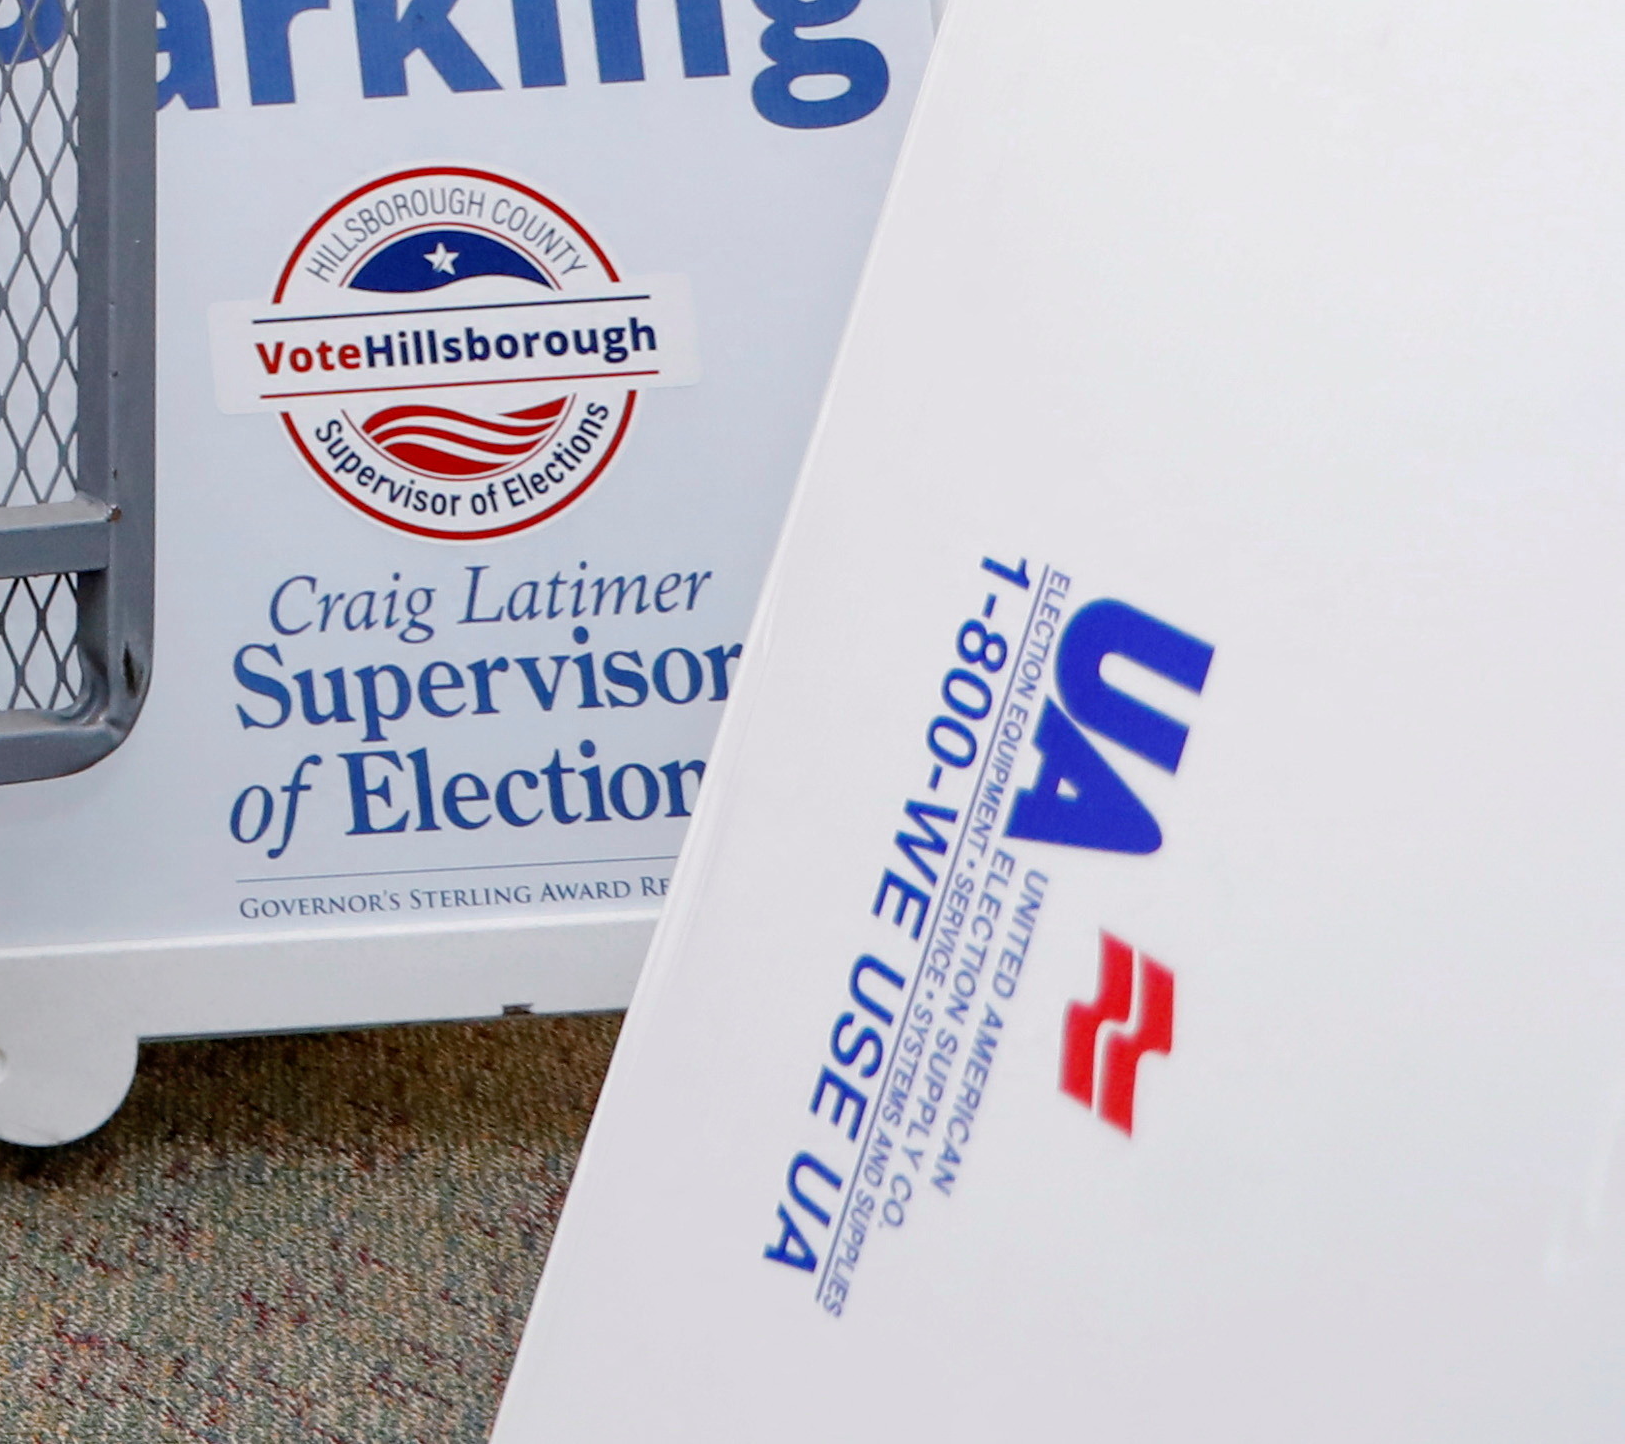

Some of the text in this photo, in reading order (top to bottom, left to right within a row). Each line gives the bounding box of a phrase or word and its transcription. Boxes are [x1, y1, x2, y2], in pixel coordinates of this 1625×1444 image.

[305, 187, 589, 283] HILLSBOROUGH COUNTY
[256, 316, 657, 376] VoteHillsborough
[315, 401, 610, 517] Supervisor of Elections
[269, 561, 712, 643] Craig Latimer
[232, 627, 743, 743] Supervisor
[1004, 596, 1216, 857] UA
[230, 739, 708, 859] of Election
[239, 889, 401, 920] GOVERNOR'S
[410, 884, 533, 911] STERLING
[539, 879, 632, 904] AWARD
[763, 556, 1030, 1273] 1-800-WE USE UA
[823, 569, 1071, 1317] ELECTION EQUIPMENT SERVICE SYSTEMS AND SUPPLIES
[878, 848, 1016, 1231] ELECTION SUPPLY CO.
[931, 869, 1049, 1196] UNITED AMERICAN
